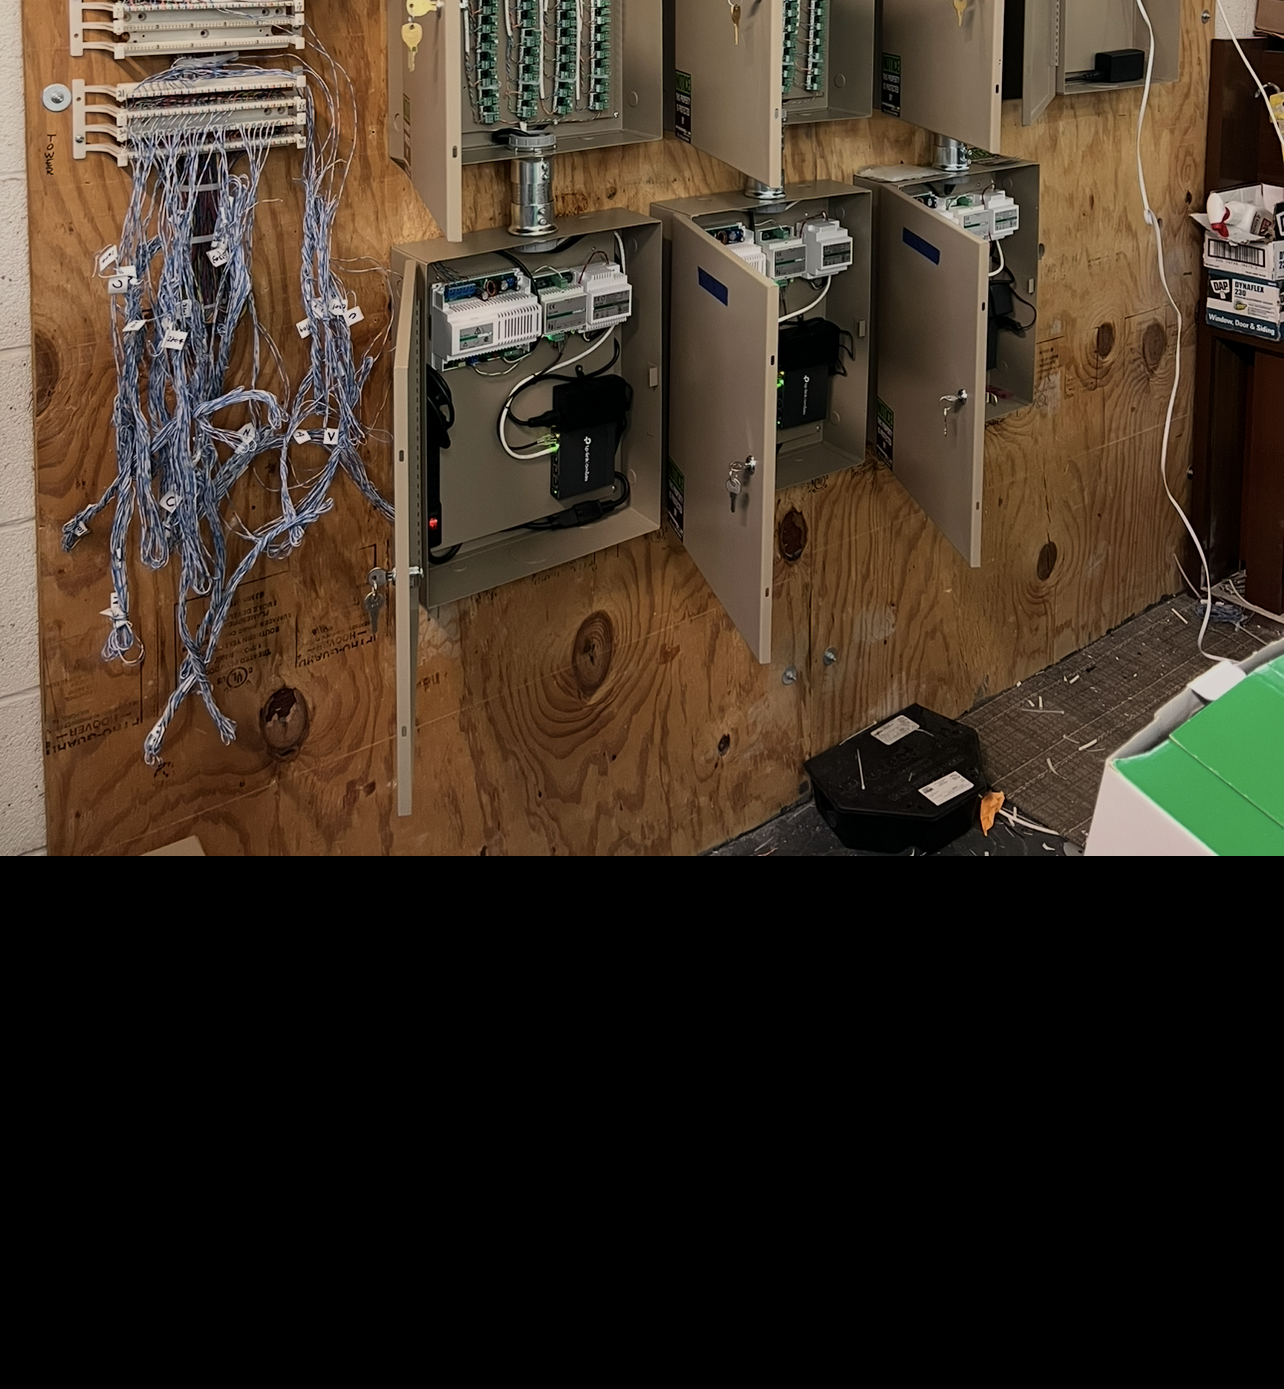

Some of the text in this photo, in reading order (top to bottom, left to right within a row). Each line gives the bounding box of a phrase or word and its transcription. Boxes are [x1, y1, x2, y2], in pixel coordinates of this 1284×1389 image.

[45, 133, 57, 176] TOWER
[1213, 281, 1228, 291] DAP
[1234, 281, 1264, 293] DYNAFLEX
[1208, 313, 1275, 336] Window, Door & Siding
